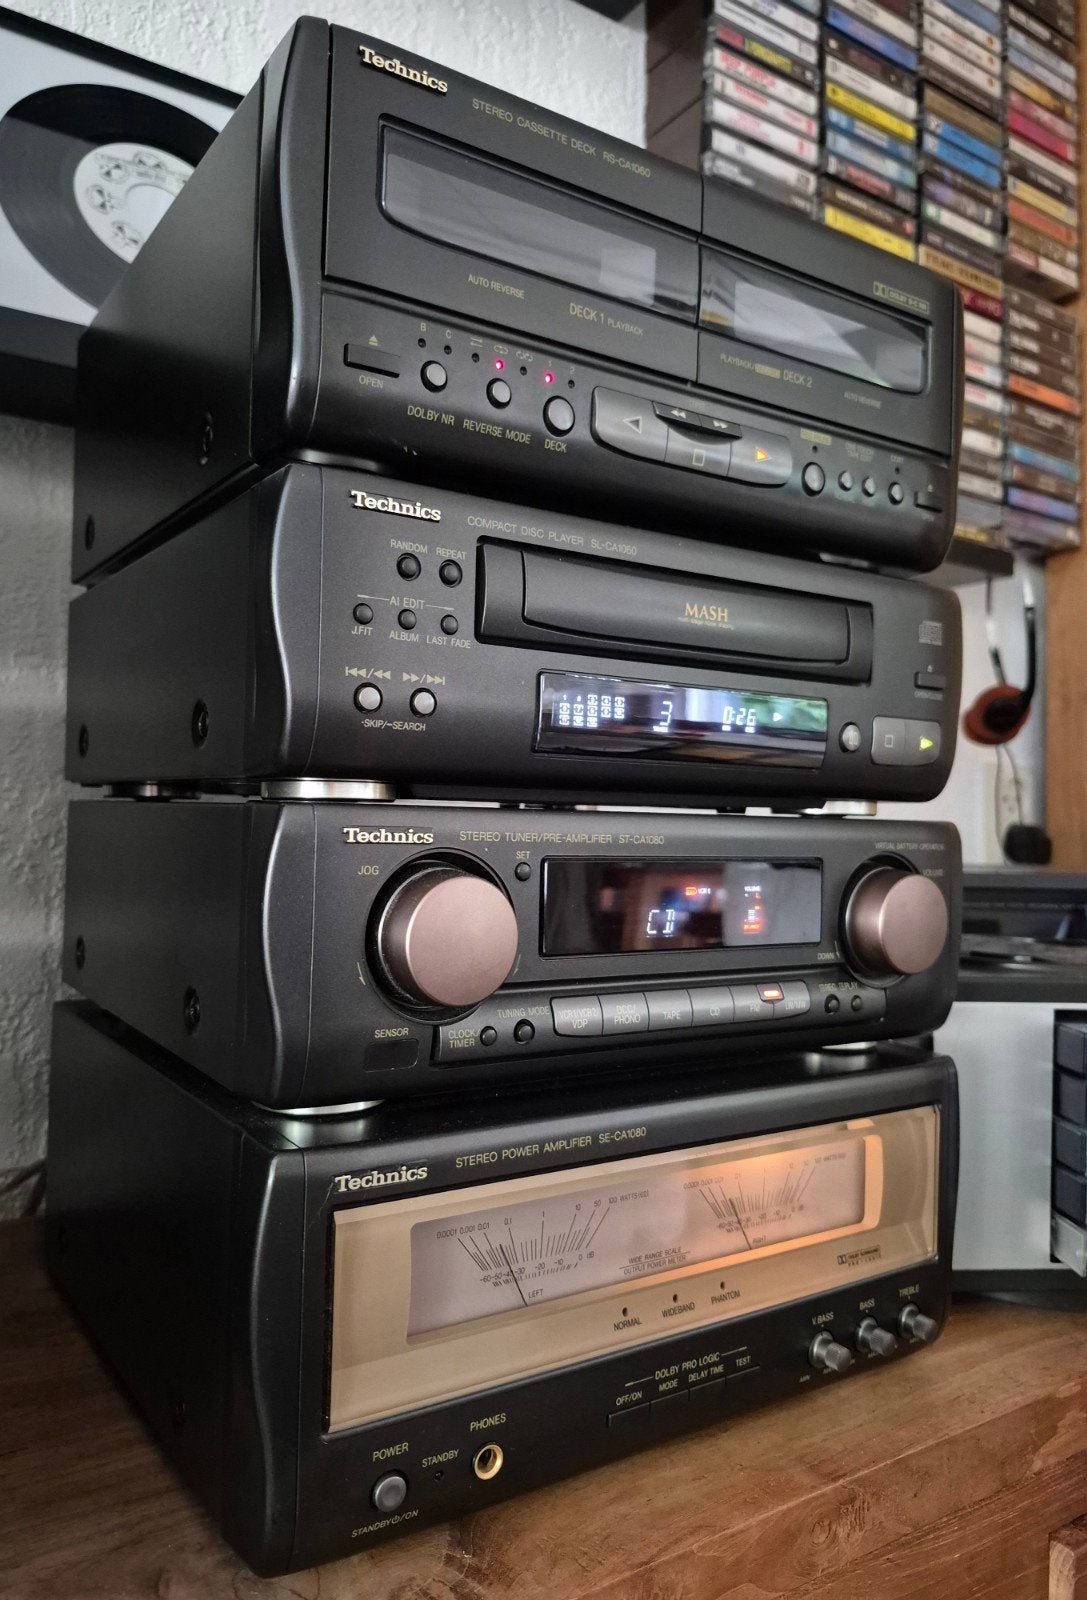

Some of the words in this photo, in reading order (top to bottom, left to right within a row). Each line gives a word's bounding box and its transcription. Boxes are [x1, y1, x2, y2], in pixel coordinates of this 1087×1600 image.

[359, 45, 448, 93] Technics
[472, 98, 513, 123] STEREO
[517, 116, 567, 145] CASSETTE
[570, 137, 596, 157] DECK
[468, 274, 490, 288] AUTO
[491, 281, 525, 299] REVERSE
[569, 302, 597, 323] DECK
[600, 312, 605, 324] 1
[420, 322, 427, 332] B
[445, 329, 452, 339] C
[607, 318, 644, 337] PLAYBACK
[359, 375, 384, 389] OPEN
[783, 369, 806, 386] DECK
[806, 377, 813, 389] 2
[407, 405, 440, 422] DOLBY
[441, 413, 455, 426] NR
[463, 419, 503, 438] REVERSE
[505, 428, 532, 445] MODE
[544, 439, 568, 453] DECK
[351, 489, 442, 521] Technics
[467, 515, 517, 534] COMPACT
[521, 526, 544, 539] DISC
[548, 530, 584, 546] PLAYER
[390, 539, 428, 554] RANDOM
[436, 547, 466, 560] REPEAT
[389, 596, 400, 606] AI
[403, 597, 426, 610] EDIT
[685, 602, 728, 622] MASH
[351, 626, 373, 636] J.FIT
[389, 630, 419, 642] ALBUM
[426, 635, 448, 646] LAST
[451, 638, 471, 649] FADE
[343, 827, 434, 845] Technics
[459, 830, 501, 842] STEREO
[505, 832, 612, 844] TUNER/PRE-AMPLIFIER
[516, 850, 530, 859] SET
[357, 865, 379, 876] JOG
[497, 1008, 526, 1019] TUNING
[527, 1005, 550, 1016] MODE
[614, 1014, 641, 1025] PHONO
[663, 1010, 681, 1021] TAPE
[709, 1007, 720, 1017] CD
[572, 1018, 588, 1029] VDP
[374, 1027, 409, 1039] SENSOR
[449, 1038, 475, 1048] TIMER
[455, 1151, 498, 1168] STEREO
[502, 1143, 540, 1160] POWER
[543, 1135, 592, 1152] AMPLIFIER
[598, 1126, 647, 1144] SE-CA1080
[335, 1165, 428, 1193] Technics
[436, 1228, 459, 1239] 0.0001
[459, 1225, 476, 1235] 0.001
[477, 1222, 490, 1231] 0.01
[503, 1217, 513, 1226] 0.1
[628, 1254, 643, 1264] WIDE
[644, 1250, 663, 1260] RANGE
[664, 1246, 681, 1256] SCALE
[624, 1264, 646, 1275] OUTPUT
[646, 1259, 667, 1270] POWER
[667, 1254, 686, 1265] METER
[528, 1288, 544, 1299] LEFT
[711, 1290, 741, 1305] PHANTOM
[661, 1302, 695, 1318] WIDEBAND
[859, 1298, 876, 1311] BASS
[613, 1317, 642, 1331] NORMAL
[655, 1365, 680, 1380] DOLBY
[682, 1359, 698, 1372] PRO
[699, 1352, 720, 1366] LOGIC
[736, 1356, 751, 1367] TEST
[688, 1370, 708, 1383] DELAY
[710, 1364, 725, 1376] TIME
[658, 1379, 678, 1392] MODE
[615, 1390, 643, 1406] OFF/ON
[469, 1413, 507, 1431] PHONES
[372, 1442, 409, 1462] POWER
[421, 1449, 460, 1468] STANDBY
